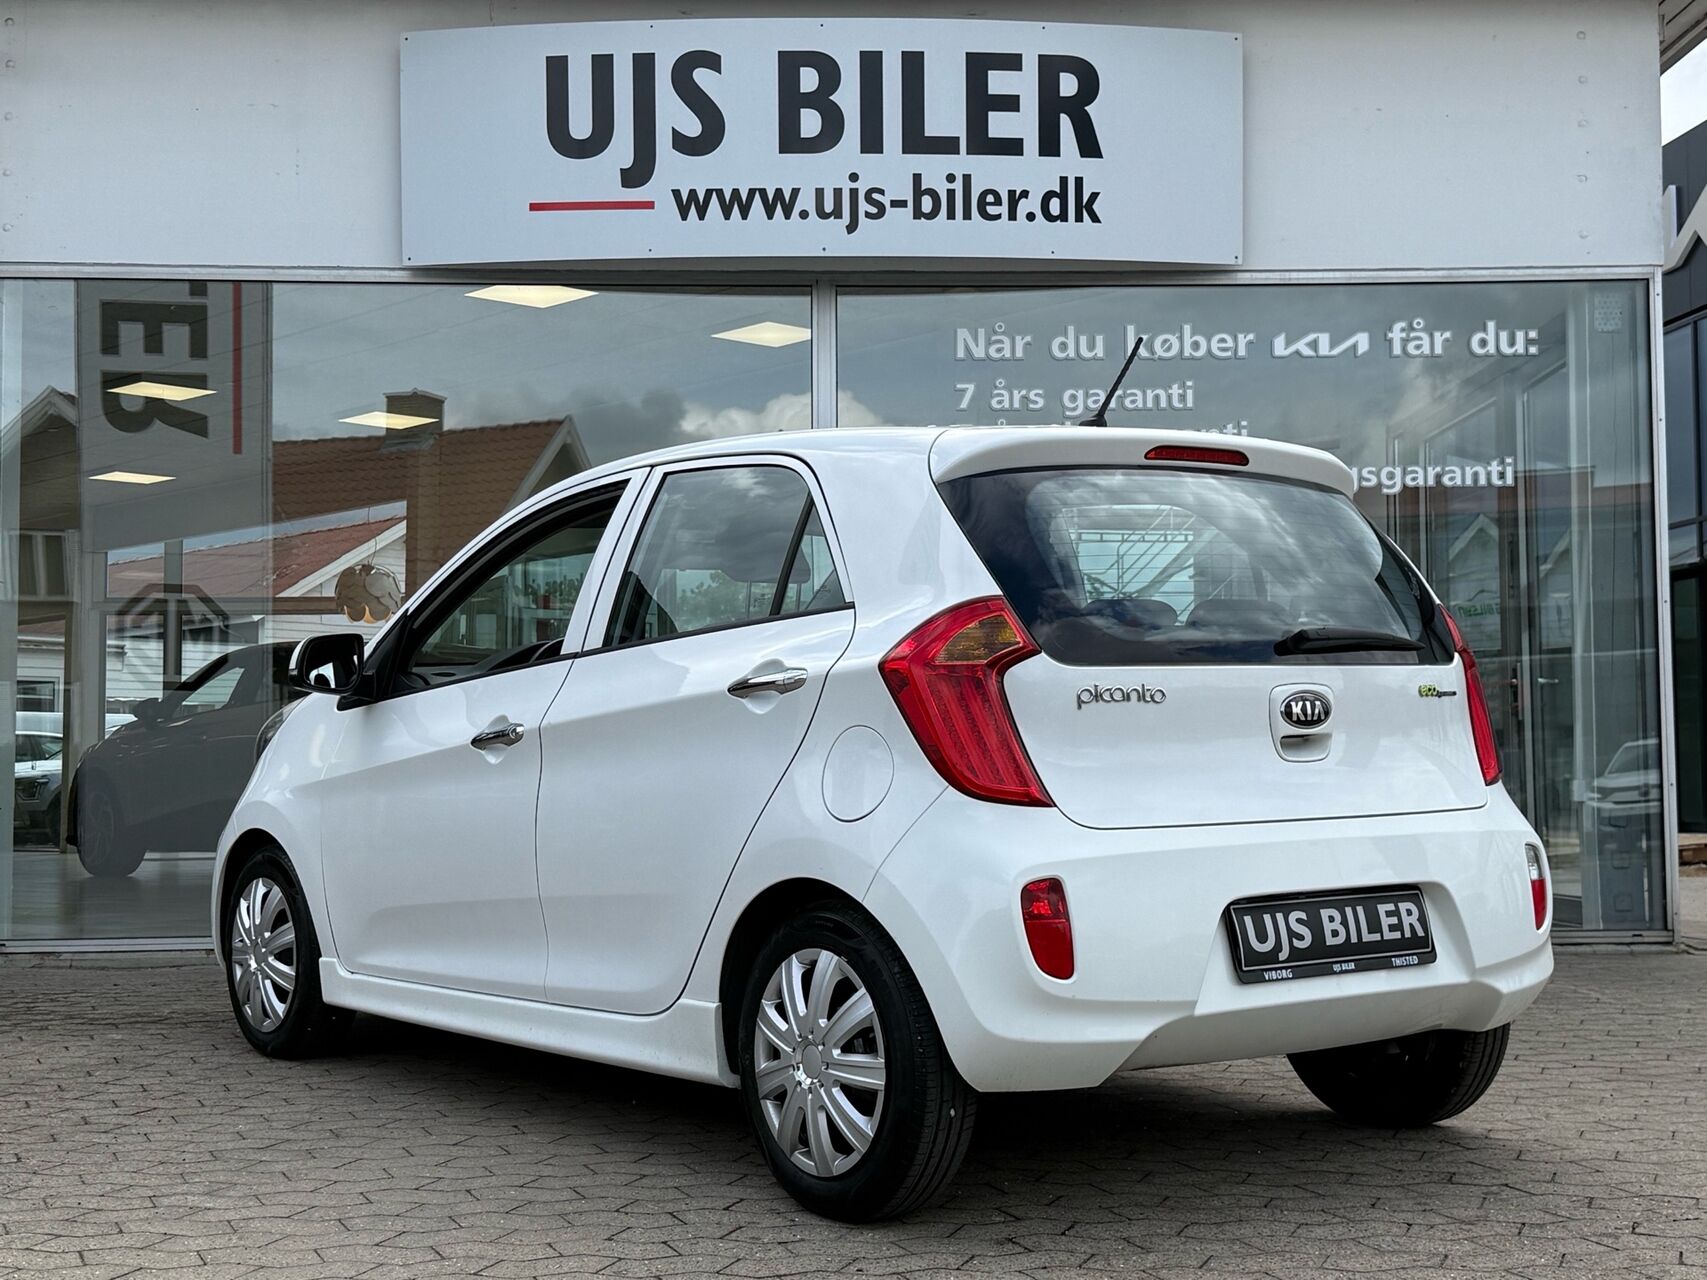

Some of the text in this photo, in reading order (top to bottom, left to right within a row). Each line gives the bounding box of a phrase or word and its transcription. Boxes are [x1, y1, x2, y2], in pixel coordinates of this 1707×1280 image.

[545, 50, 1104, 190] UJS BILER
[671, 172, 1103, 235] www.ujs-biler.dk
[954, 321, 1033, 362] Når
[1050, 324, 1106, 361] du
[1125, 322, 1256, 360] køber
[1387, 317, 1452, 358] får
[1469, 320, 1540, 358] du:
[955, 378, 1195, 419] 7 års garanti
[1076, 683, 1167, 711] picanto
[1289, 700, 1326, 721] KIA
[1243, 901, 1425, 962] UJS BILER
[1263, 968, 1293, 981] VIBORG
[1391, 955, 1419, 967] THISTED
